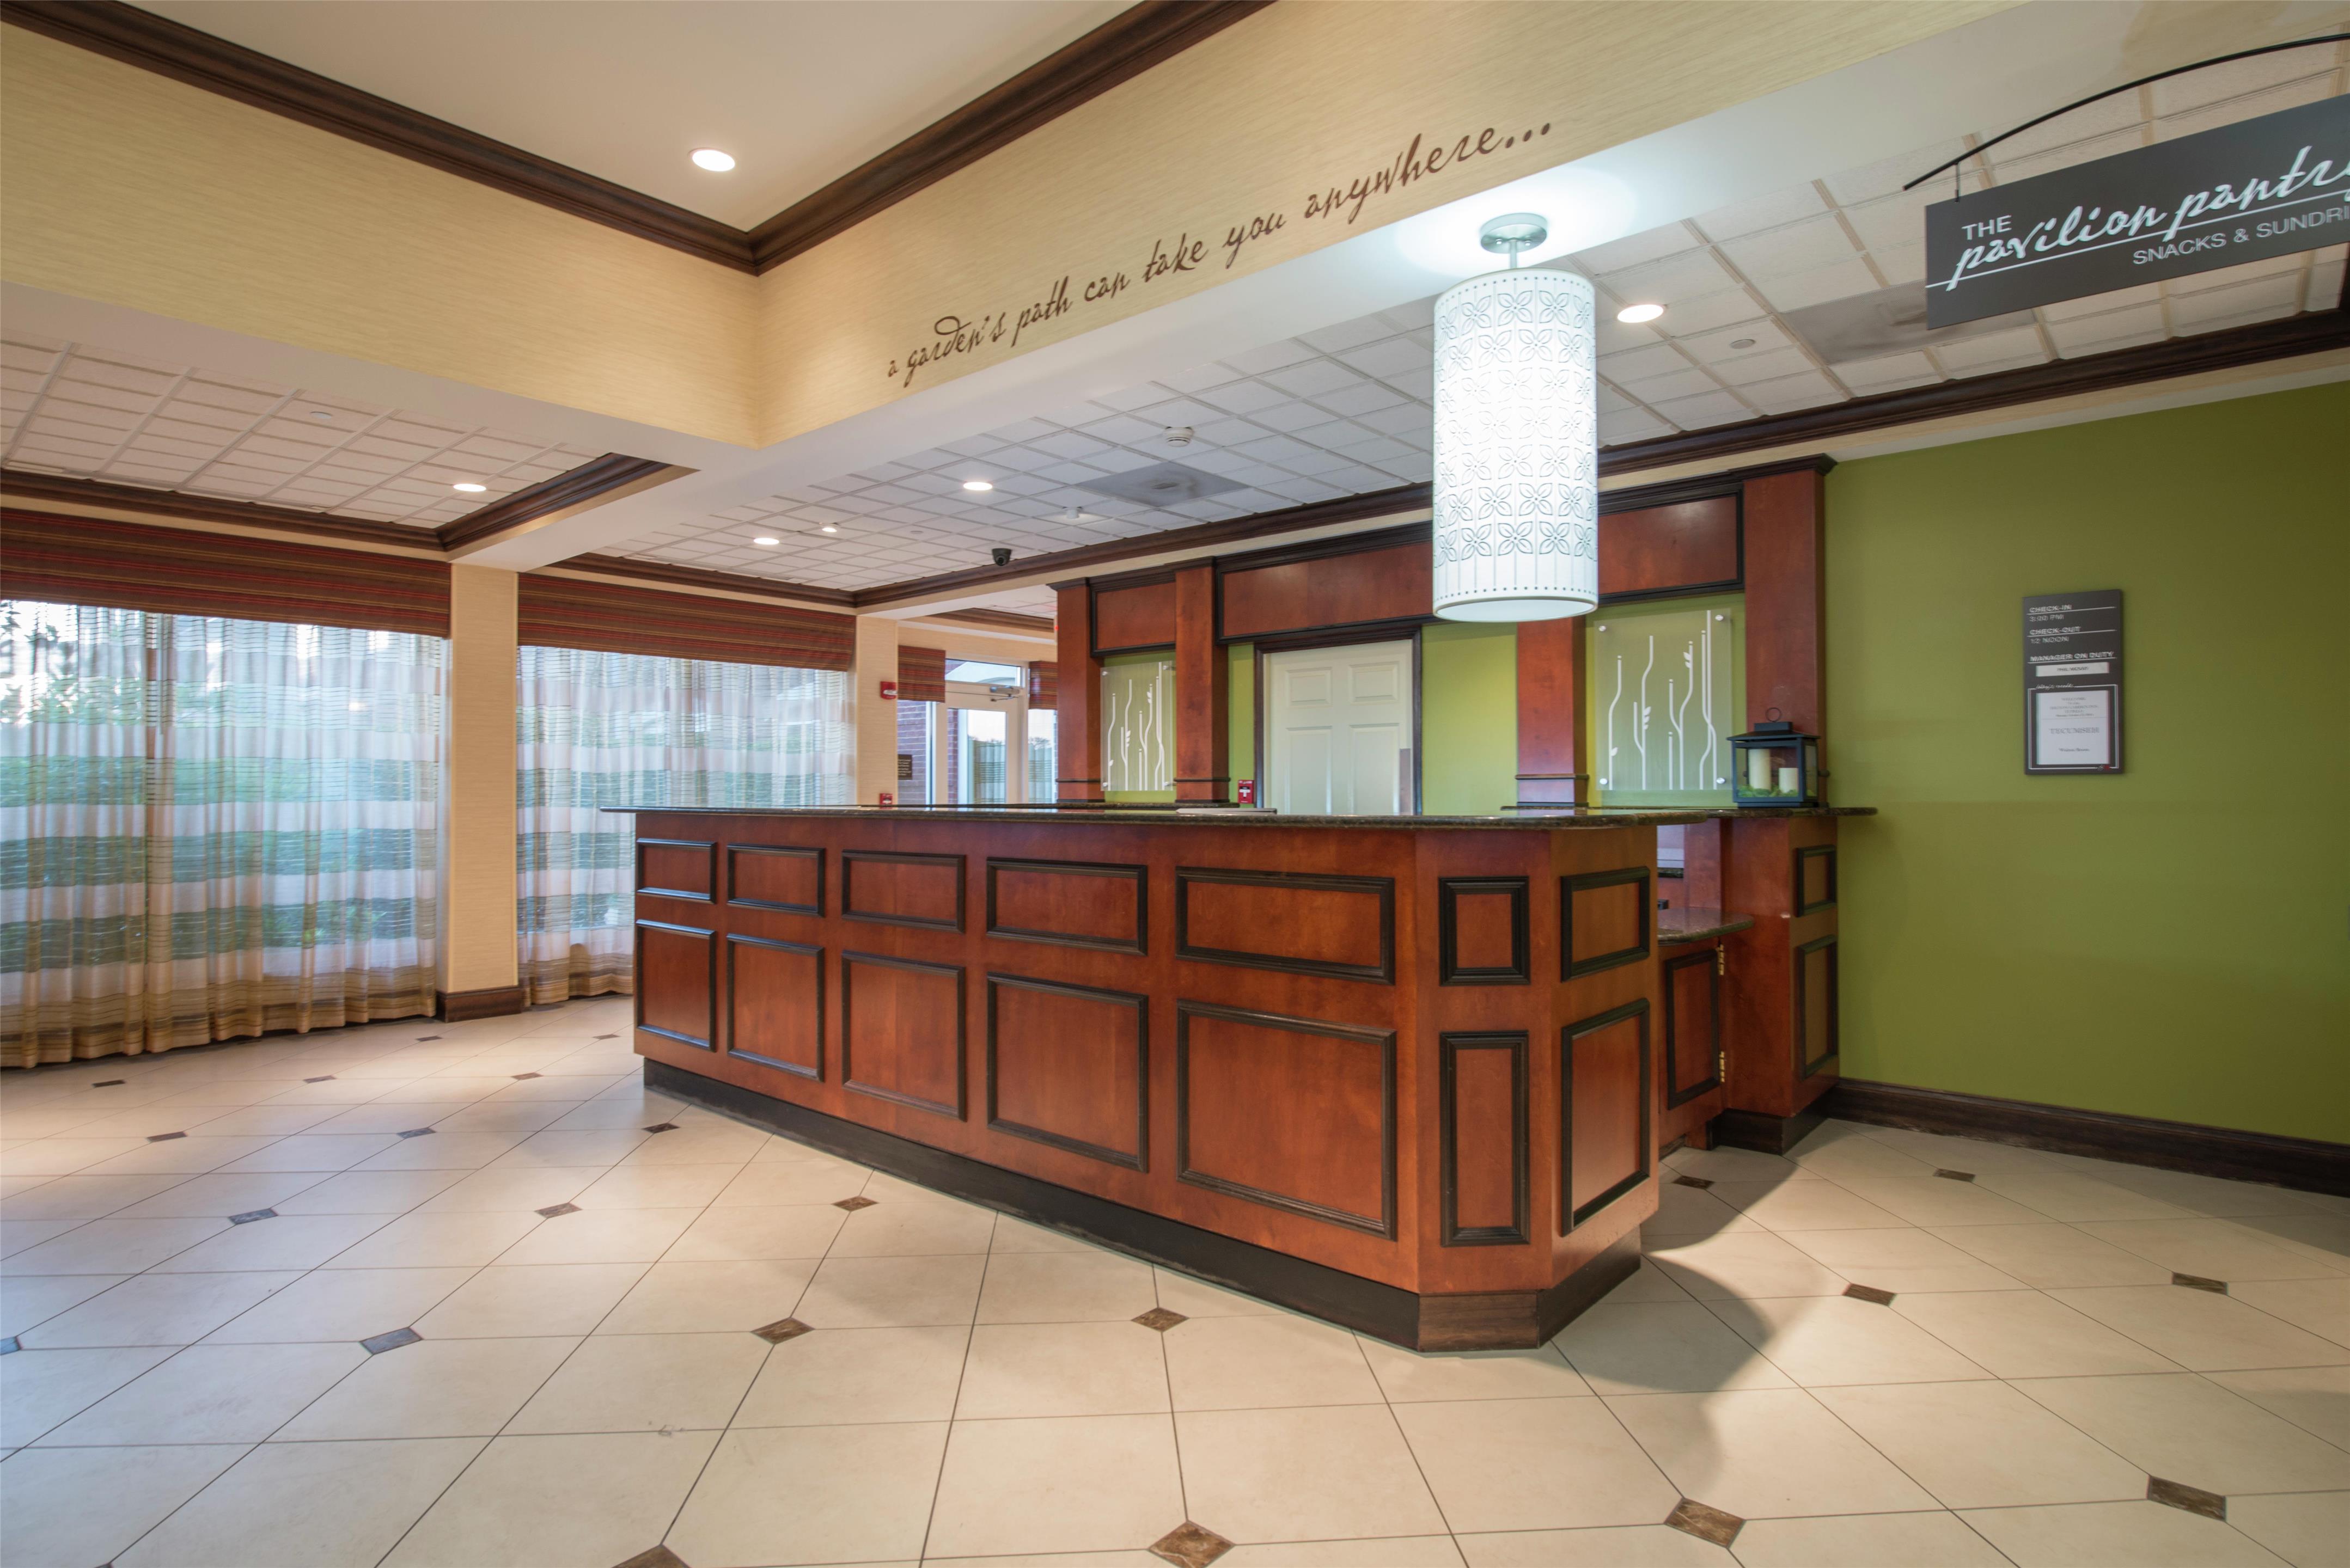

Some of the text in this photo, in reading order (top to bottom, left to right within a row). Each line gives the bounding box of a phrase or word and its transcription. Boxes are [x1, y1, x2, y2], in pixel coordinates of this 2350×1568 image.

[1946, 145, 2350, 292] pavilion pantr
[1961, 215, 2012, 240] THE
[2133, 233, 2227, 265] SNACKS
[2233, 228, 2250, 243] &
[888, 359, 899, 377] a
[902, 312, 1007, 388] garden's
[1010, 275, 1073, 348] path
[1084, 272, 1131, 302] can
[1142, 232, 1209, 283] take
[1222, 212, 1287, 270] you
[2029, 604, 2072, 613] CHECK-IN
[2030, 626, 2081, 635] CHECK-OUT
